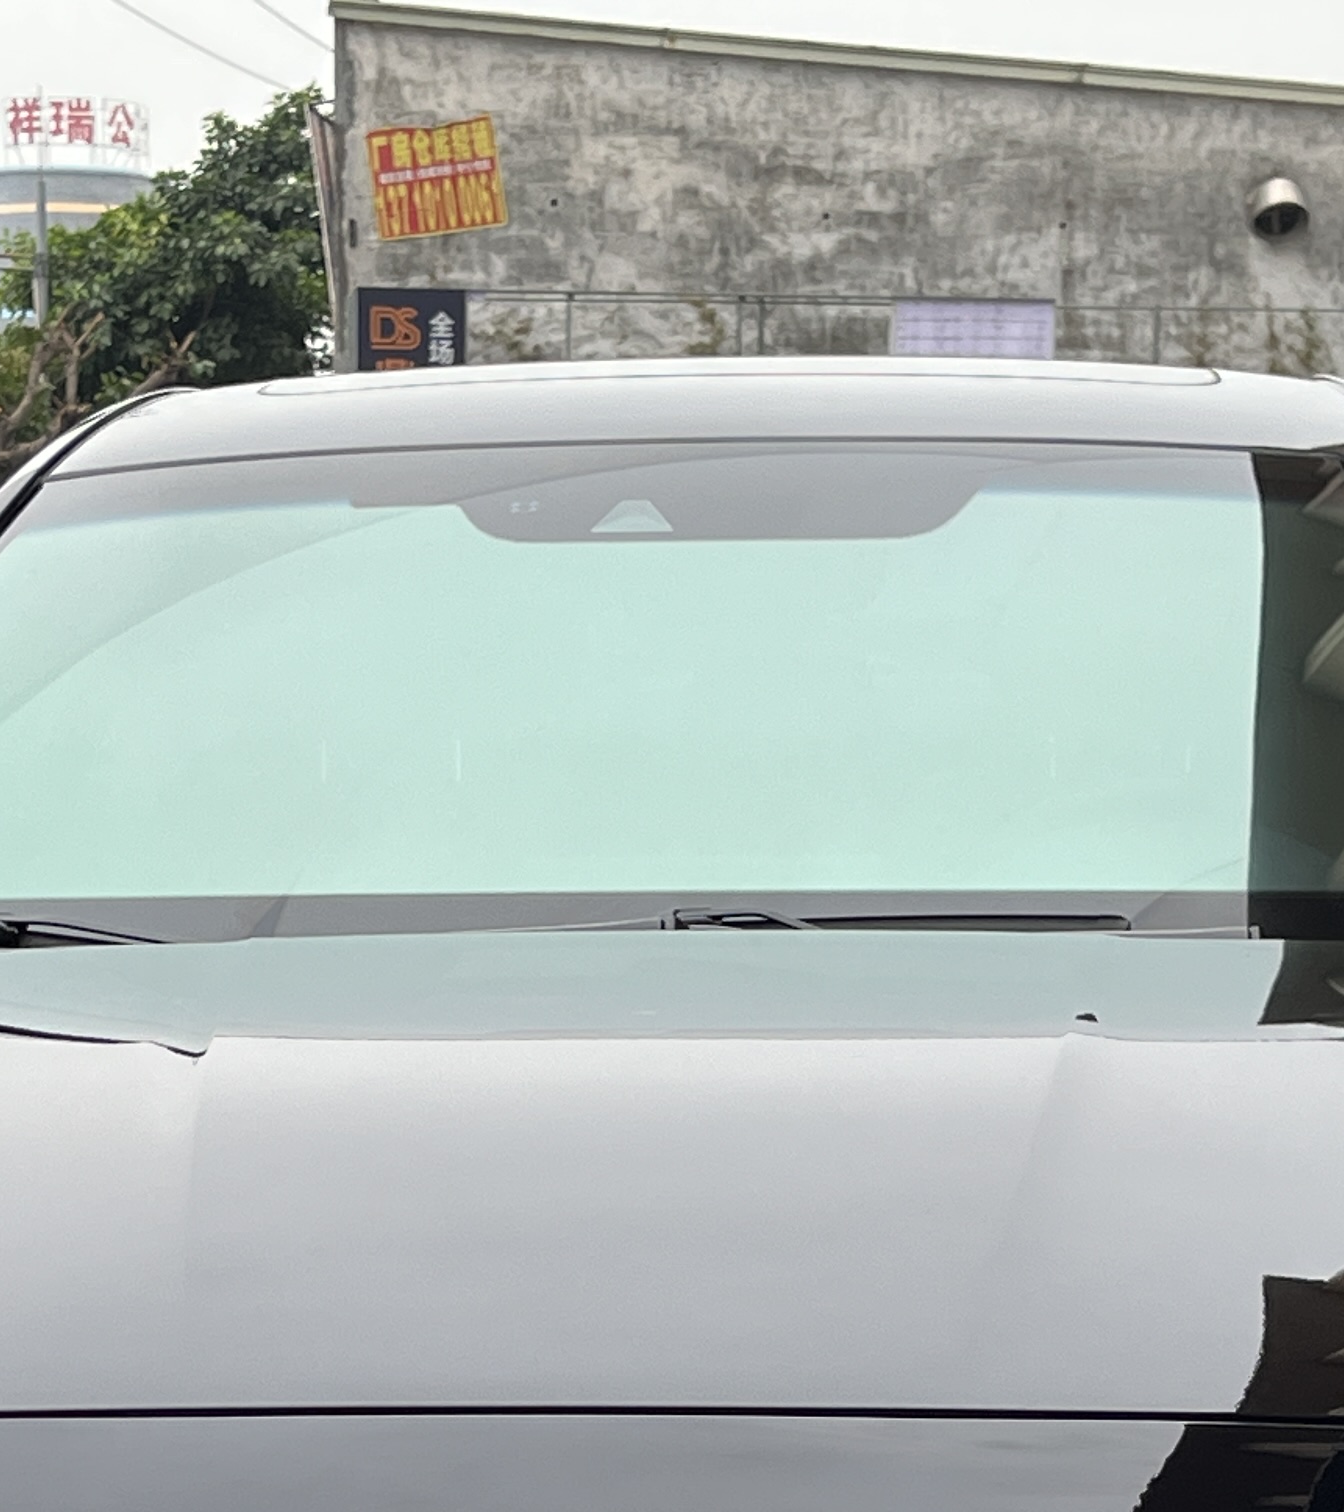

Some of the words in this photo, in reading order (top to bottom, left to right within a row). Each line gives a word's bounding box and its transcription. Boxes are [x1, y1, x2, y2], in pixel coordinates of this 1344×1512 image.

[7, 97, 134, 148] 祥瑞公
[369, 306, 421, 350] DS
[427, 311, 455, 365] 全场
